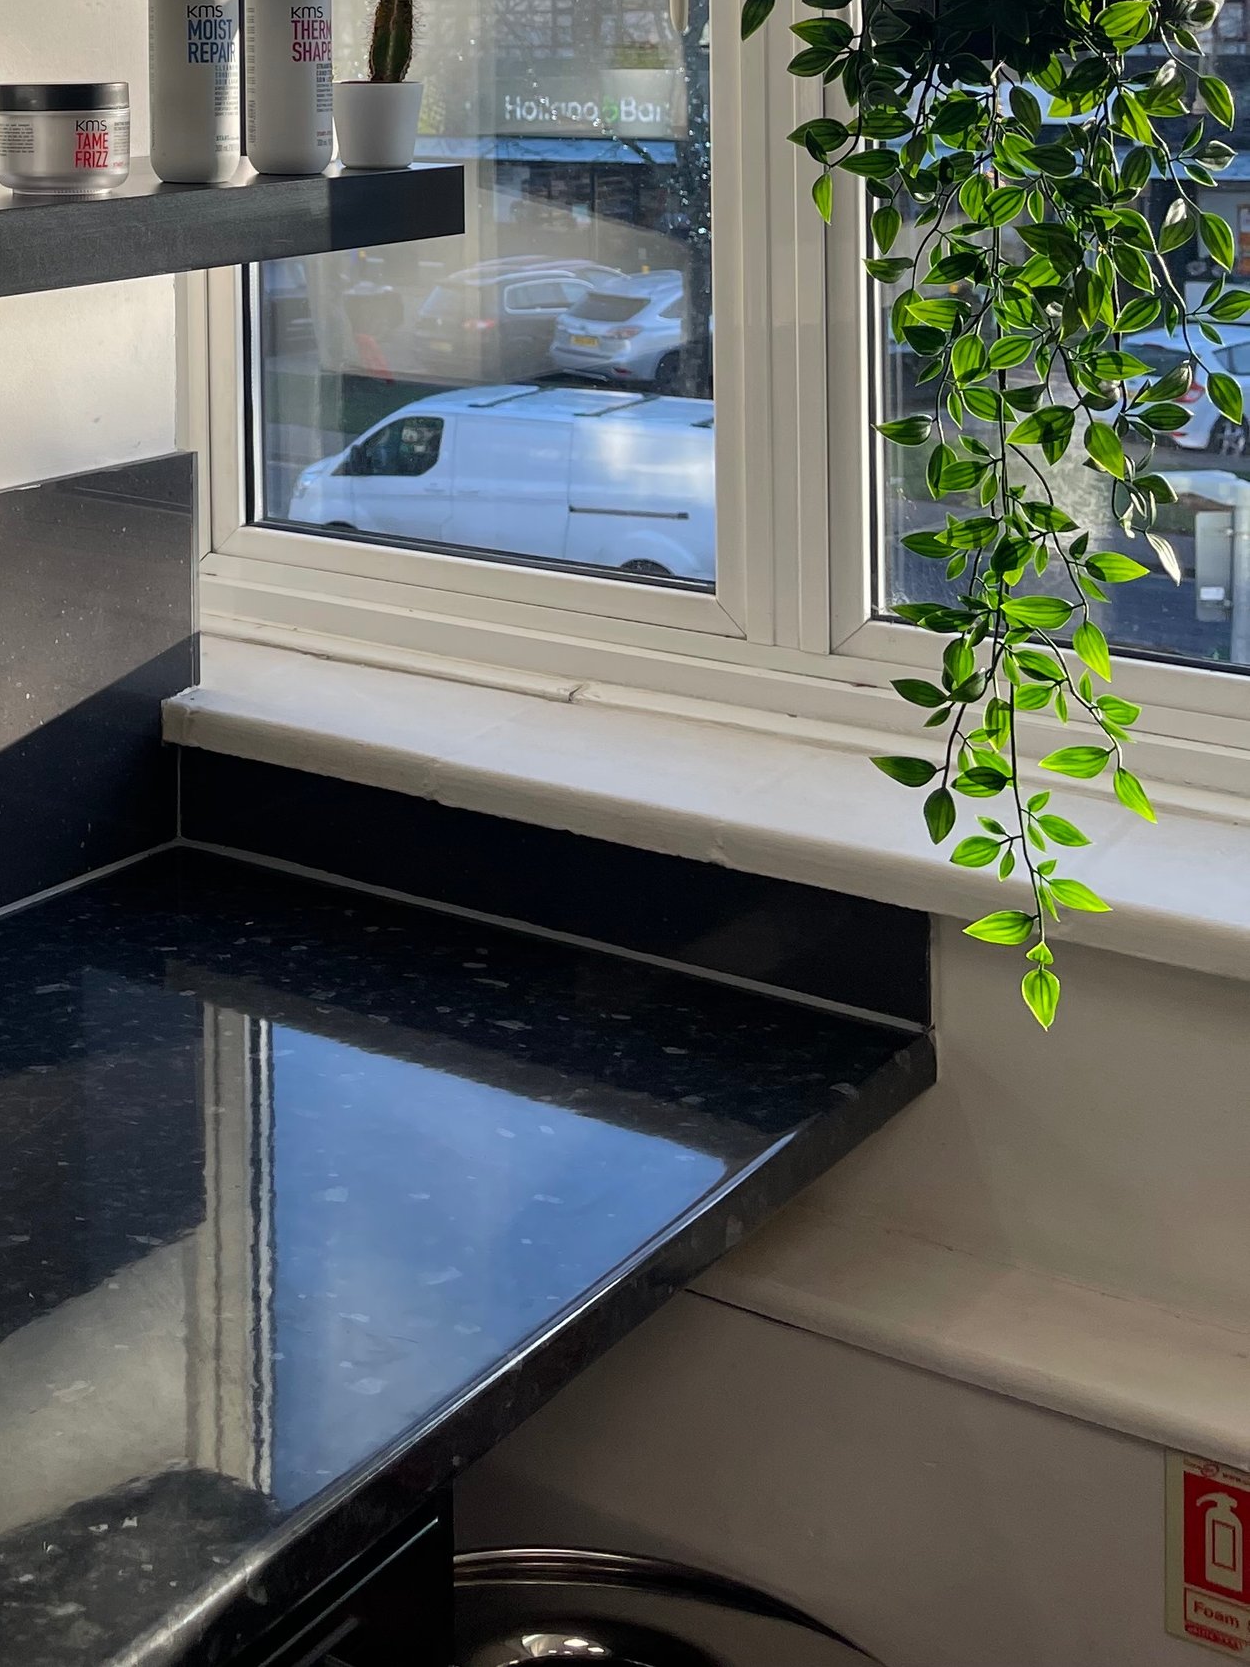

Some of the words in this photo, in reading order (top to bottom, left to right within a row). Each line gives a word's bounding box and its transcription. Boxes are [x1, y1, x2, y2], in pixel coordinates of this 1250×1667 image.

[188, 19, 232, 41] MOIST
[291, 19, 332, 41] THERM
[188, 42, 236, 63] REPAIR
[292, 42, 332, 63] SHAPE
[76, 133, 109, 150] TAME
[75, 150, 108, 168] FRIZZ
[1193, 1599, 1240, 1629] Foam
